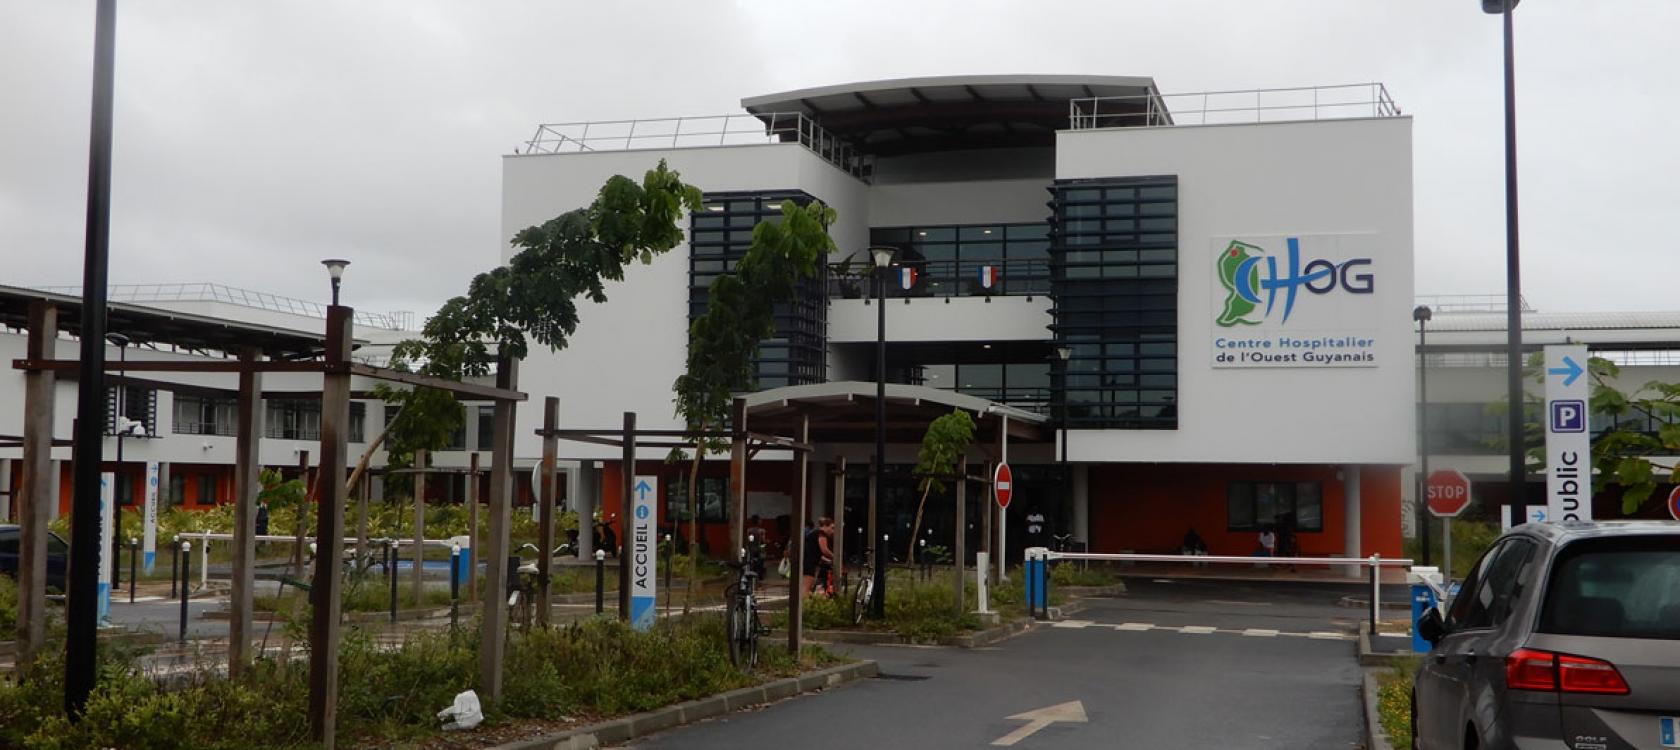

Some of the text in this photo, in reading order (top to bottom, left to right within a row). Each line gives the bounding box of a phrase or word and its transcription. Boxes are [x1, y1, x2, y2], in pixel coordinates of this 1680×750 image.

[1215, 336, 1374, 350] Centre Hospitalier
[1215, 351, 1374, 365] de l'Ouest Guyanais
[1560, 407, 1576, 427] P
[1427, 485, 1464, 499] STOP
[635, 523, 648, 589] ACCUEIL
